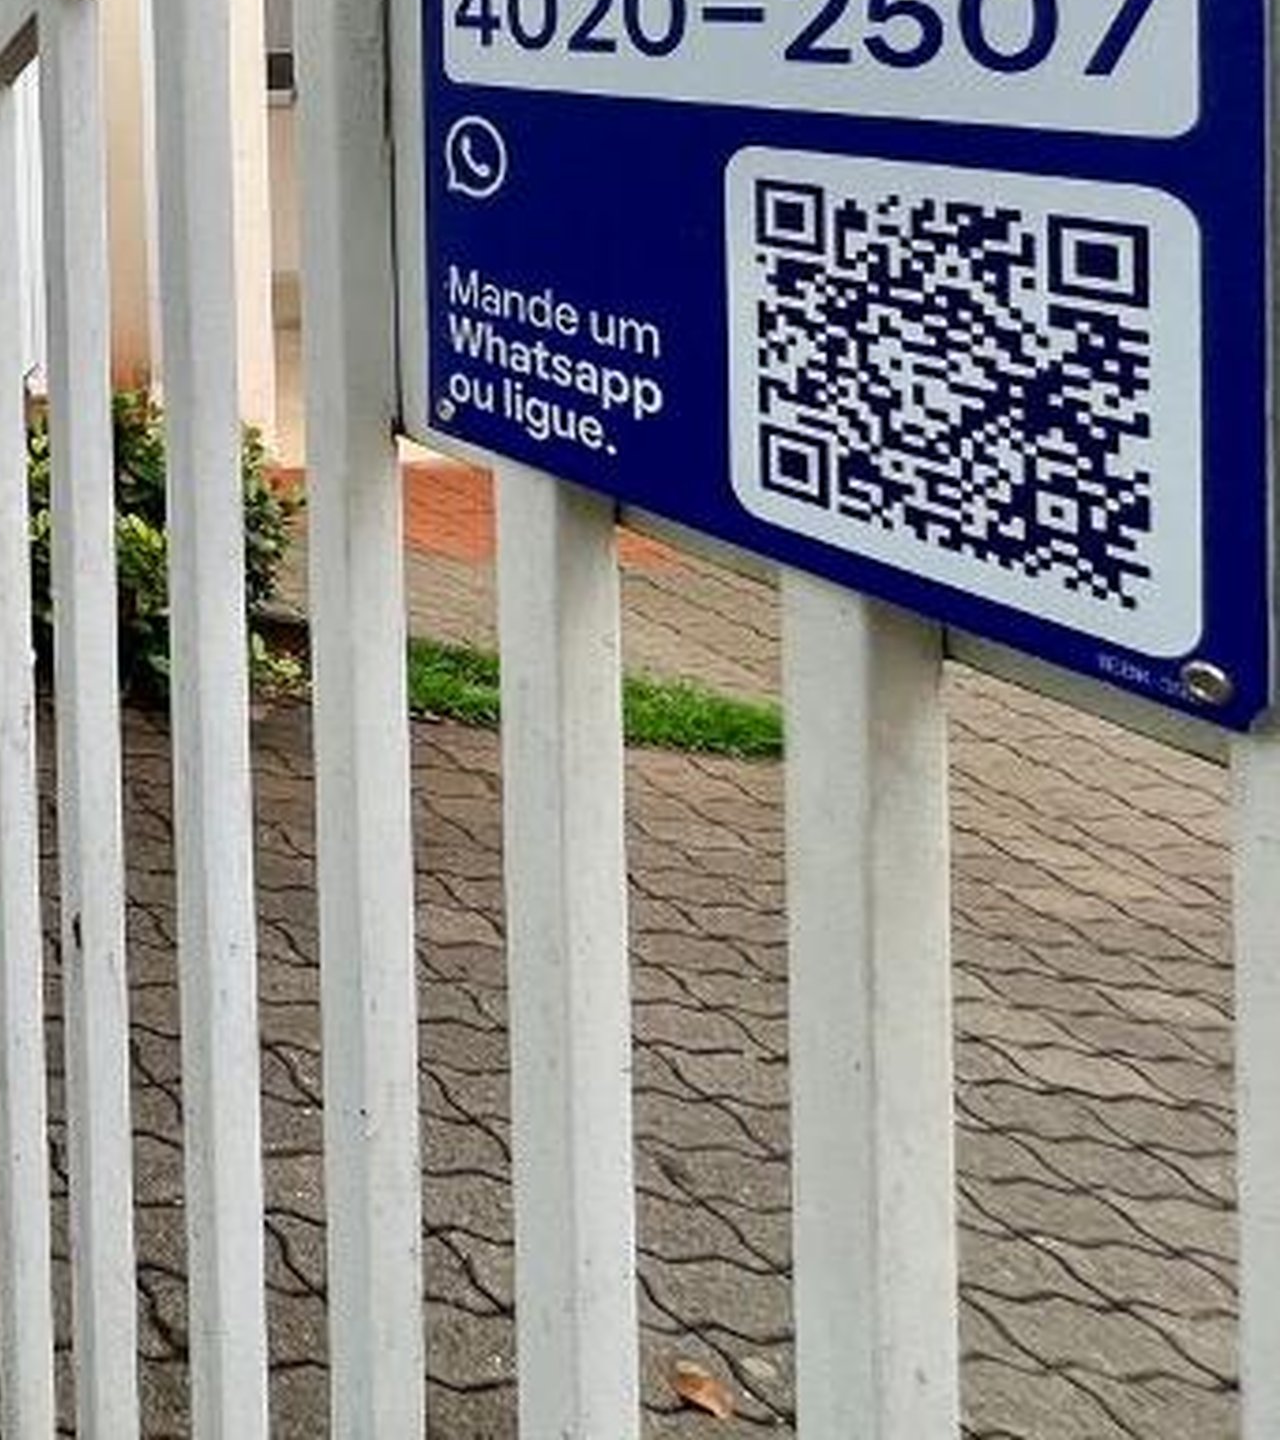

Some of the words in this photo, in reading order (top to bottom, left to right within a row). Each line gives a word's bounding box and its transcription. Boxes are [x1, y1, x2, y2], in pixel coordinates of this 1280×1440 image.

[448, 264, 579, 336] Mande
[590, 310, 660, 358] um
[448, 313, 663, 421] Whatsapp
[449, 372, 494, 414] ou
[503, 377, 618, 455] ligue.
